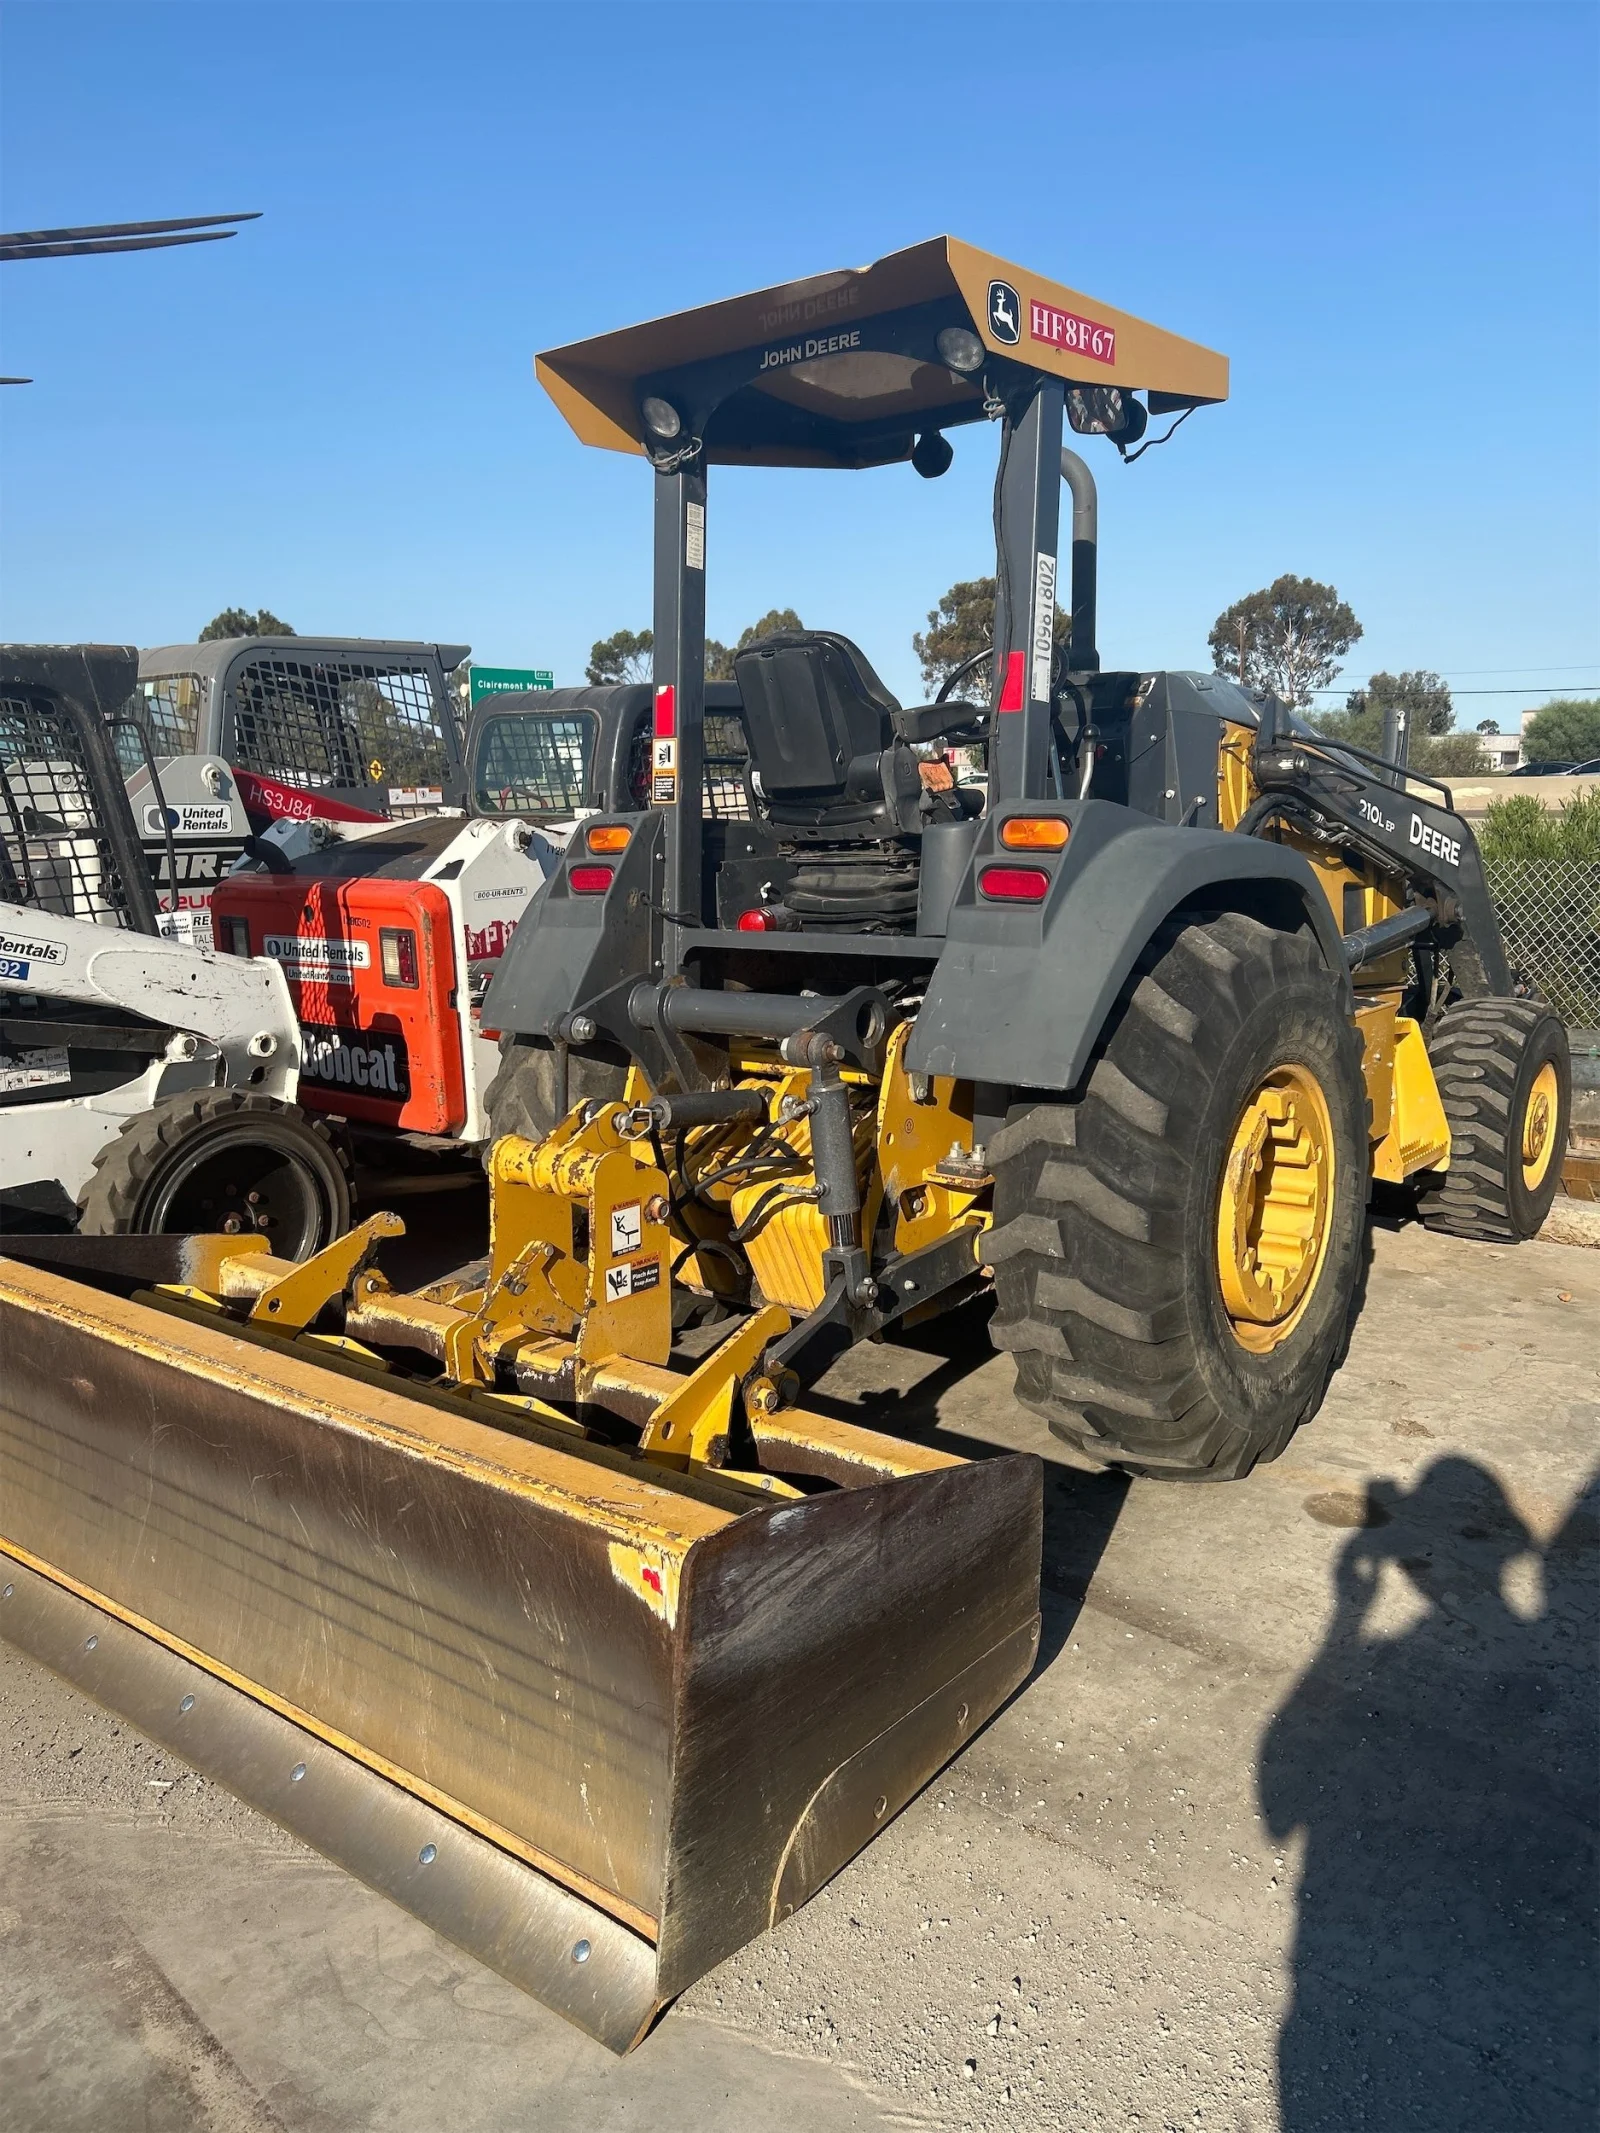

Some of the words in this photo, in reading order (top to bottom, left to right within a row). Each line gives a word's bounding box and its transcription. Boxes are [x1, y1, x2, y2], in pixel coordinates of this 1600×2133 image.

[1031, 305, 1115, 359] HF8F67
[760, 345, 802, 370] JOHN
[805, 330, 861, 358] DEERE
[477, 679, 524, 691] Clairemont
[526, 682, 547, 692] Mesa
[182, 807, 224, 819] United
[249, 784, 314, 819] HS3J84
[182, 817, 229, 831] Rentals
[1359, 799, 1385, 829] 210L
[1385, 819, 1396, 833] EP
[1409, 813, 1461, 867] DEERE
[477, 887, 524, 899] 800-UR-RENTS
[283, 941, 319, 959] United
[322, 944, 364, 962] Rentals
[301, 1031, 399, 1092] Bobcat
[632, 1271, 646, 1280] Pinch
